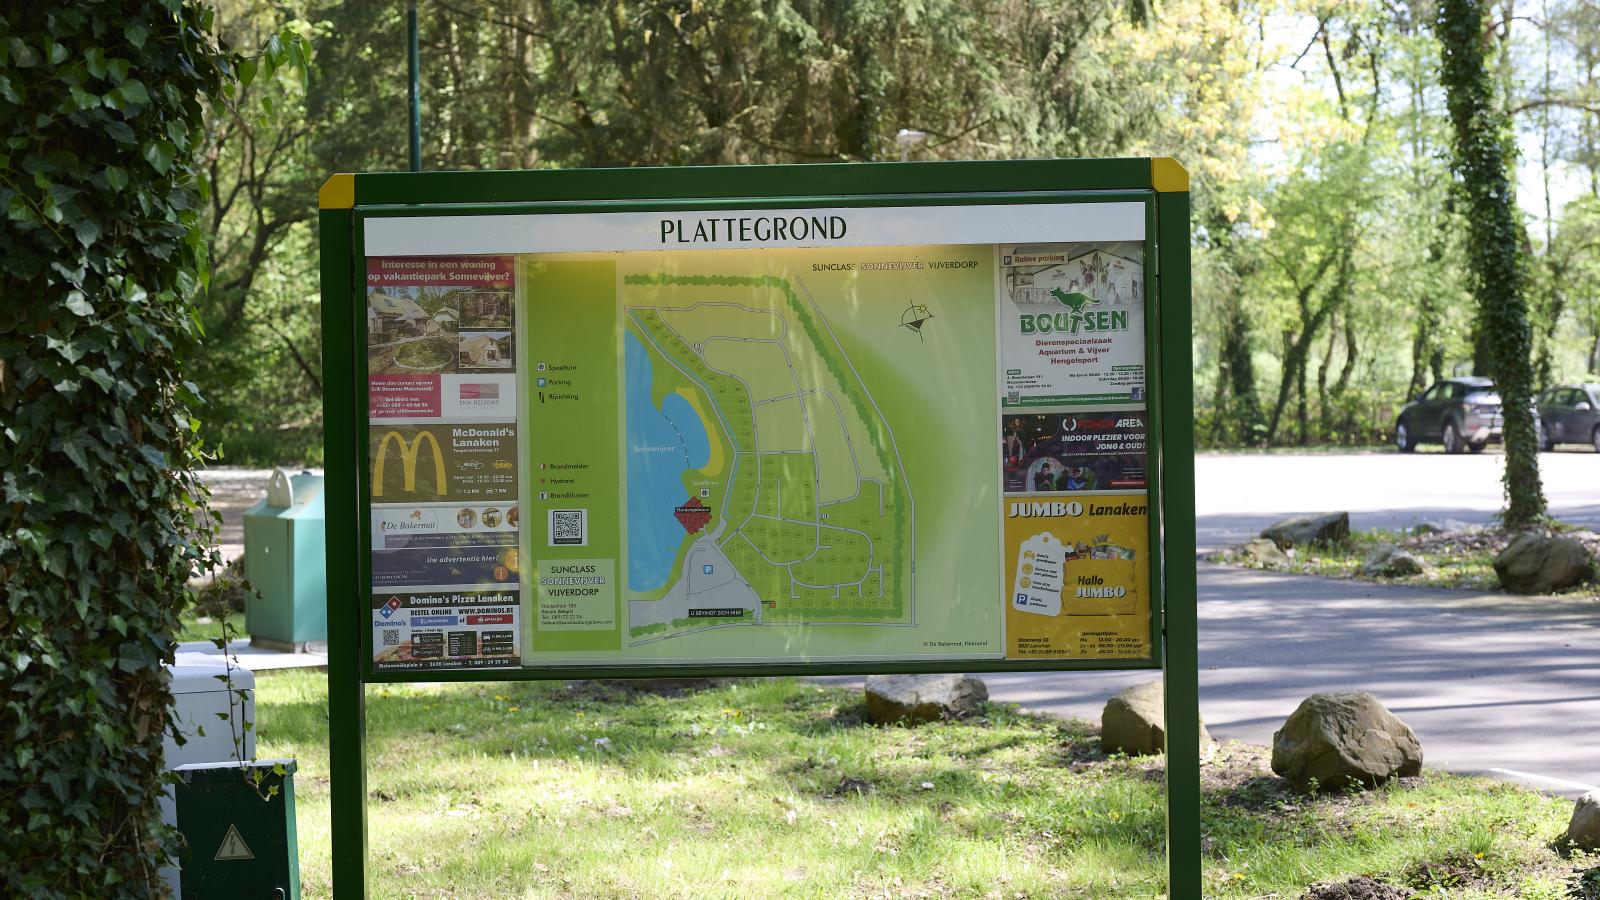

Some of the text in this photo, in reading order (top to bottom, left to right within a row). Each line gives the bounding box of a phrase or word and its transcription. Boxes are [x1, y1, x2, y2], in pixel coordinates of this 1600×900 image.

[661, 216, 848, 244] PLATTEGROND
[1038, 254, 1065, 263] parking
[381, 260, 426, 269] Interesse
[428, 260, 438, 269] in
[460, 260, 496, 270] woning
[812, 261, 978, 271] SUNCLASS SONNEVIJVER VIJVERDORP
[367, 272, 510, 283] op vakantiepark Sonnevijver?
[1020, 310, 1129, 335] BOUTSEN
[1035, 337, 1113, 347] Dierenspeciaalzaak
[1038, 348, 1076, 356] Aquarium
[1087, 347, 1110, 355] Vijver
[1050, 356, 1099, 365] Hengelsport
[1115, 418, 1144, 428] AREA
[452, 428, 514, 437] McDonald's
[452, 438, 500, 447] Lanaken
[1008, 501, 1084, 519] JUMBO
[1088, 503, 1148, 516] Lanaken
[386, 521, 436, 530] De Bakermat
[439, 556, 479, 564] advertentie
[550, 565, 596, 574] SUNCLASS
[541, 576, 606, 585] SONNEVIJVER
[1077, 576, 1104, 586] Hallo
[548, 588, 600, 597] VIJVERDORP
[1075, 586, 1127, 599] JUMBO
[410, 593, 514, 605] Domino's Pizza Lanaken
[457, 607, 514, 615] WWW.DOMINOS.BE
